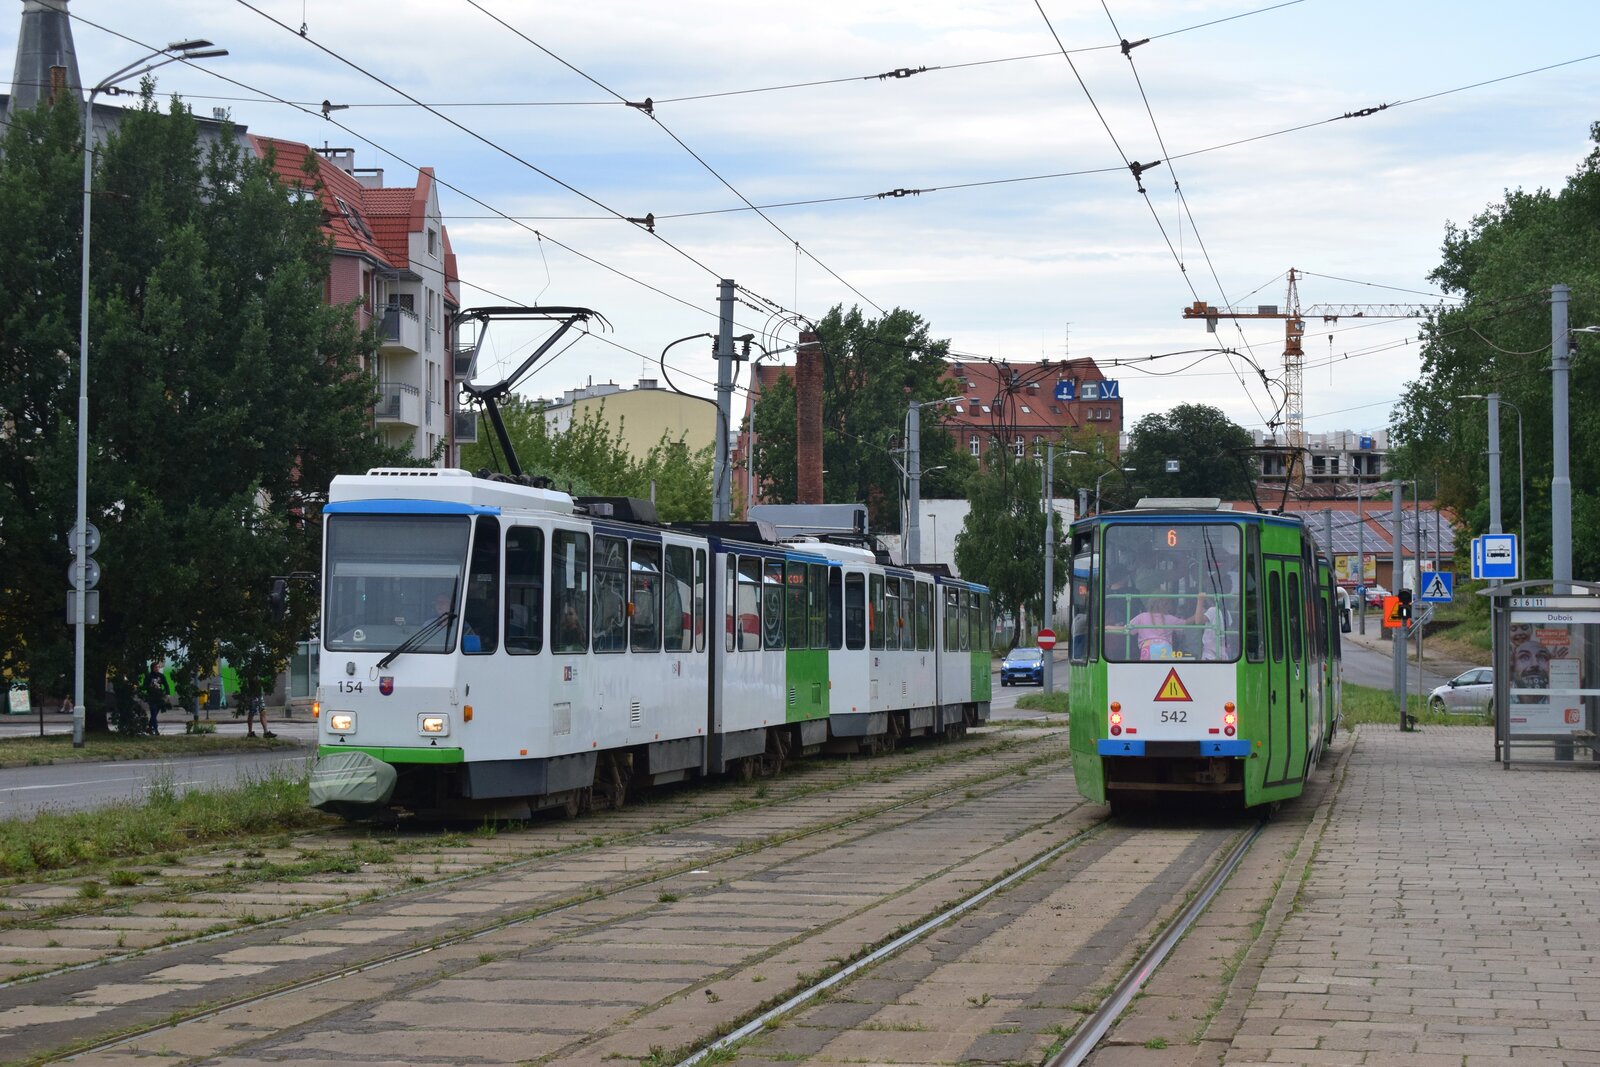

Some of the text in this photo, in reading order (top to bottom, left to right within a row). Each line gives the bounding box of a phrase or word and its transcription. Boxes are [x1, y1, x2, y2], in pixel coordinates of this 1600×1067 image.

[1167, 529, 1177, 547] 6
[337, 681, 363, 693] 154
[1161, 711, 1187, 723] 542
